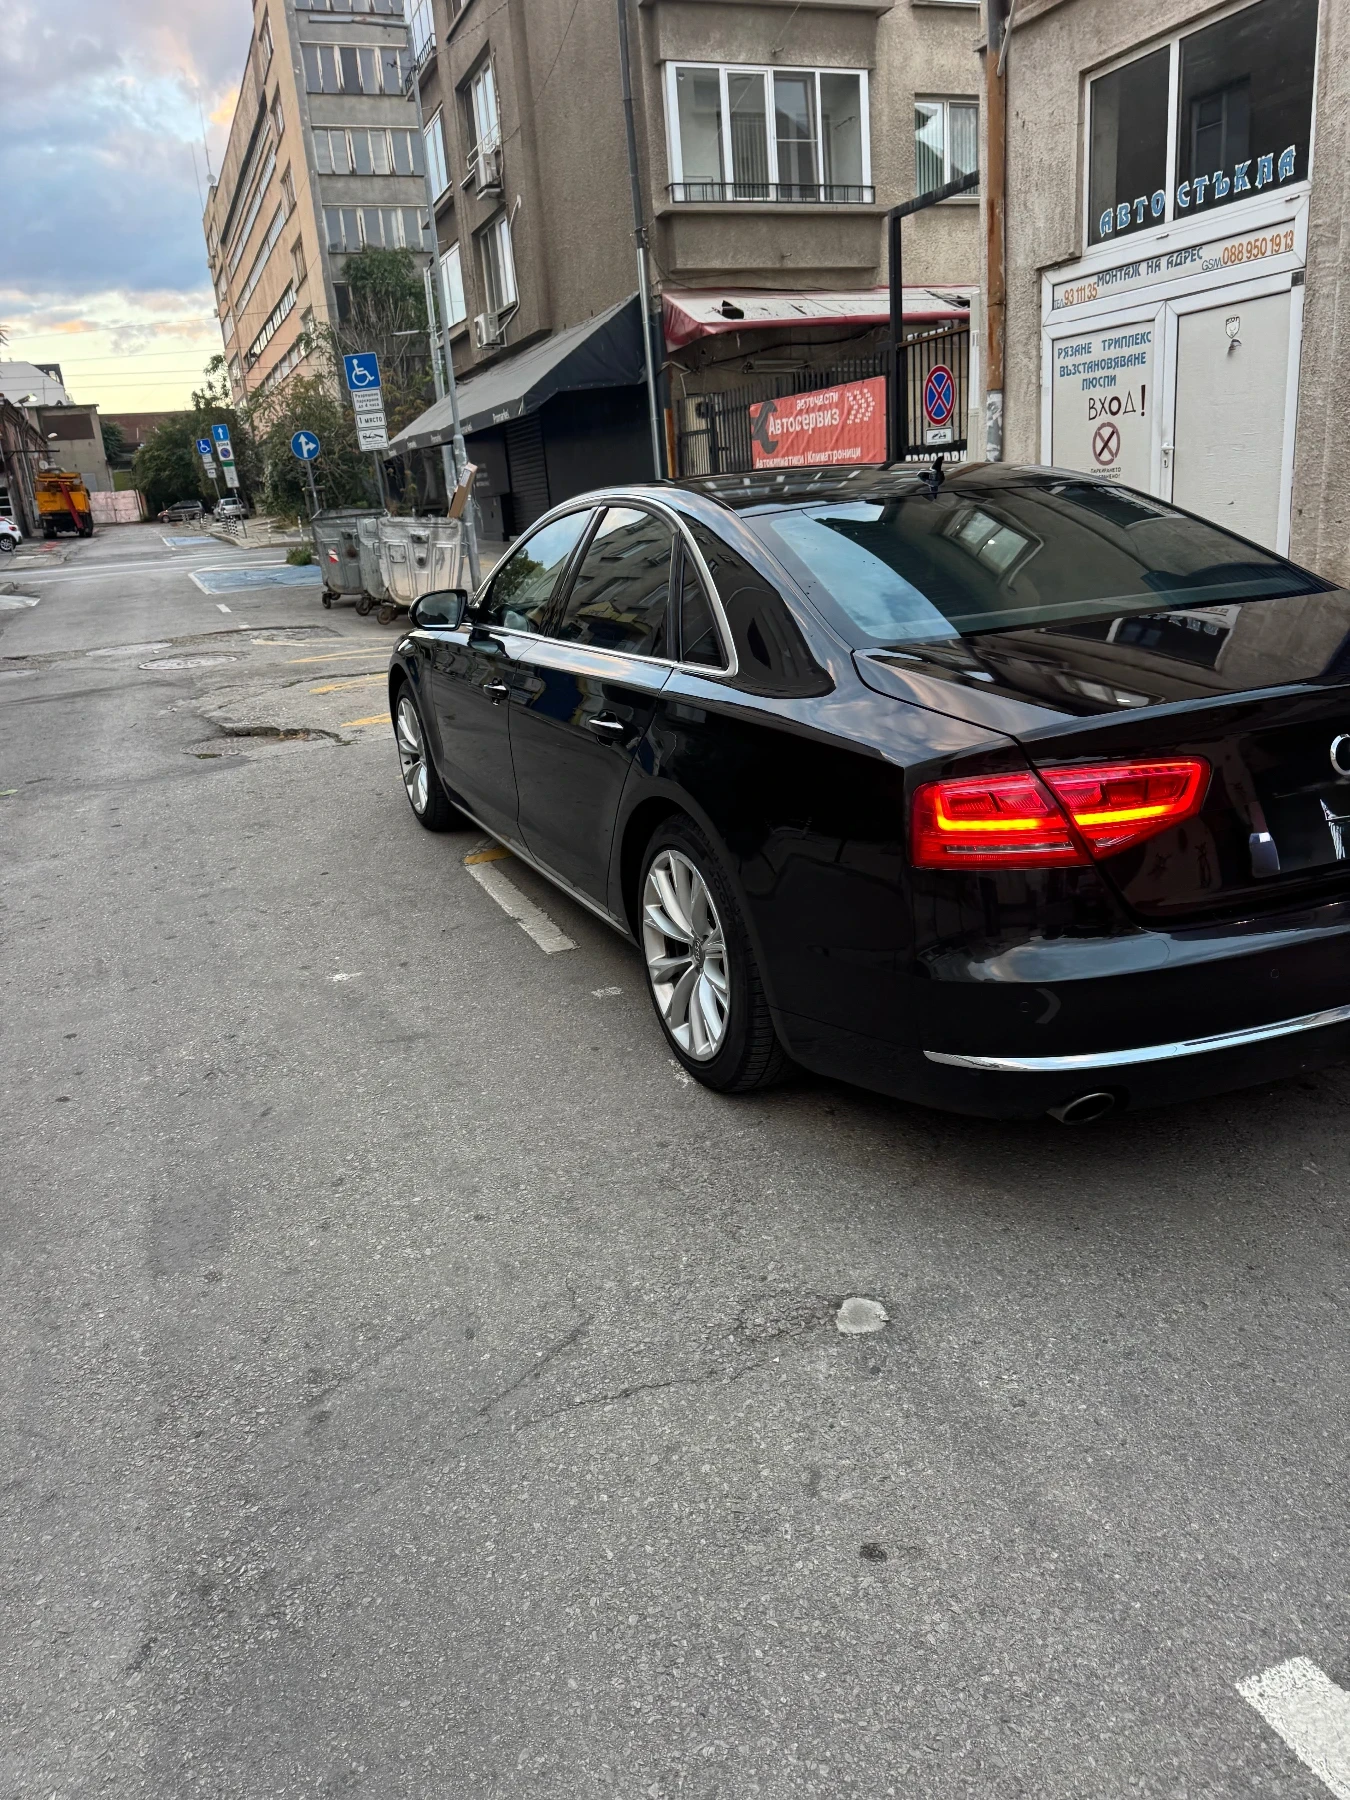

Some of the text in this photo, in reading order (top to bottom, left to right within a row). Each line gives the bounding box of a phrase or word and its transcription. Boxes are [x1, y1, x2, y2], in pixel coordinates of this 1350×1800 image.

[1099, 145, 1296, 238] АВТО СТЪКЛА
[1222, 243, 1244, 265] 088
[1246, 237, 1267, 260] 950
[1270, 233, 1281, 254] 19
[1283, 230, 1294, 251] 13
[1097, 246, 1203, 287] МОНТАЖ НА АДРЕС
[1064, 288, 1074, 306] 93
[1076, 285, 1086, 303] 111
[1087, 282, 1098, 300] 35
[1057, 342, 1092, 359] РЯЗАНЕ
[1059, 352, 1146, 377] ВЪЗСТАНОВЯВАНЕ
[796, 390, 838, 410] авточасти
[1088, 385, 1146, 421] ВХОД!
[768, 408, 840, 435] Автосервиз
[807, 447, 861, 464] Климатроници
